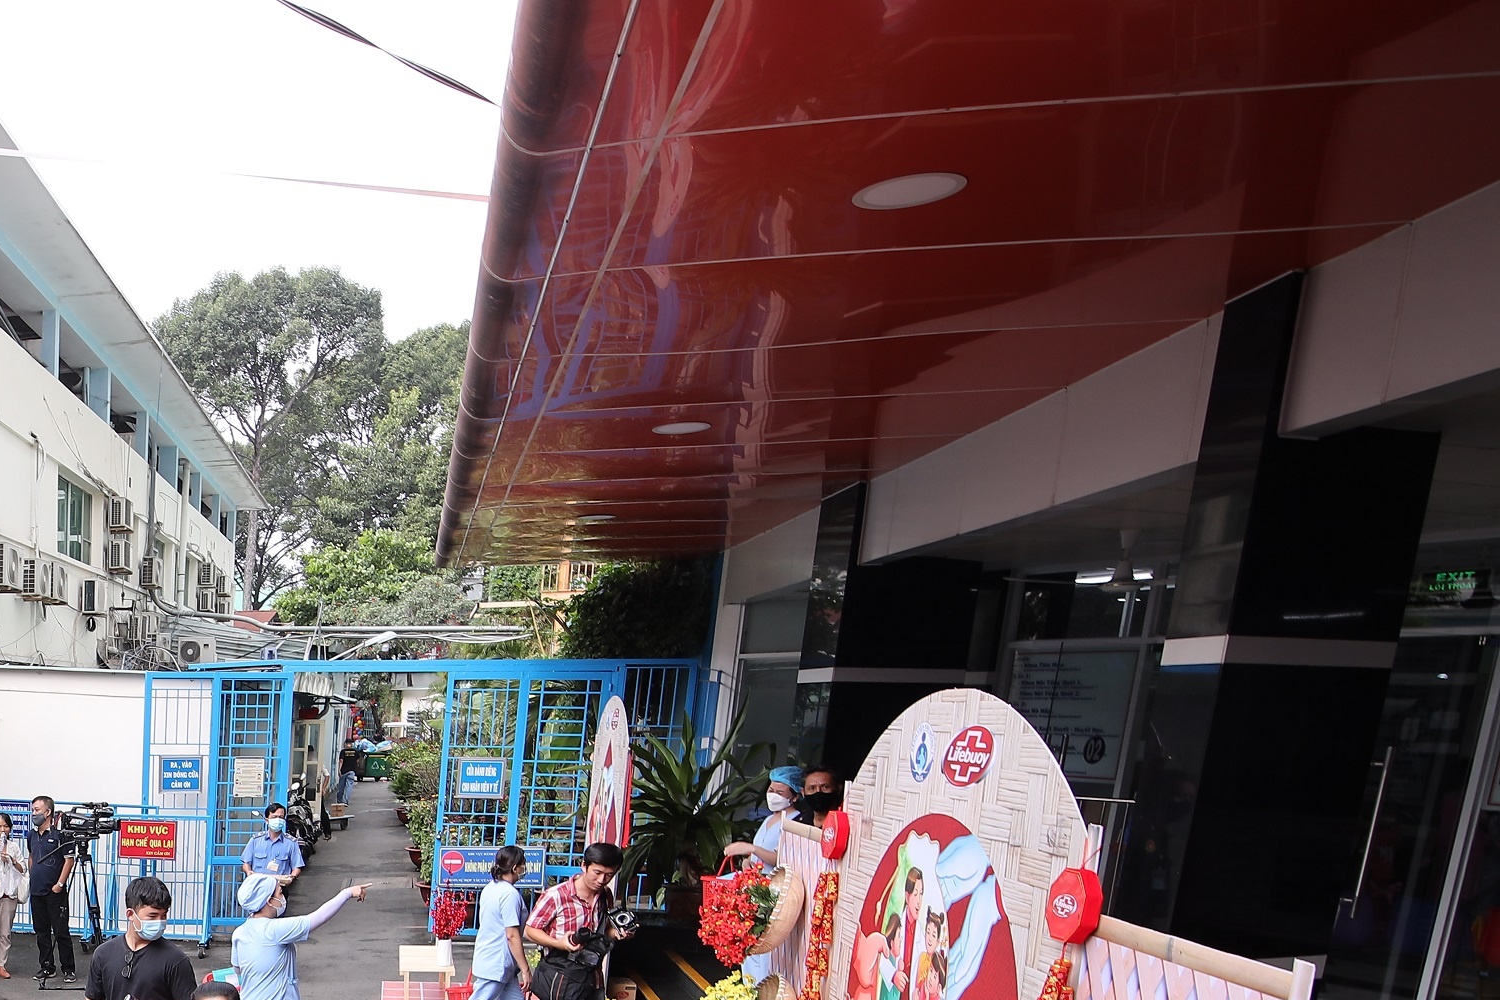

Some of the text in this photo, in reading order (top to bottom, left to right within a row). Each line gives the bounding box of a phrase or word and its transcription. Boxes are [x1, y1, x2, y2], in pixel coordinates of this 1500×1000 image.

[1436, 571, 1476, 582] EXIT
[947, 745, 990, 769] Lifebuoy
[1086, 738, 1103, 762] 02
[163, 771, 173, 779] XIN
[127, 824, 169, 836] KHU VỰC
[121, 836, 174, 850] HẠN CHẾ QUA LẠI
[464, 859, 478, 873] KHÔNG
